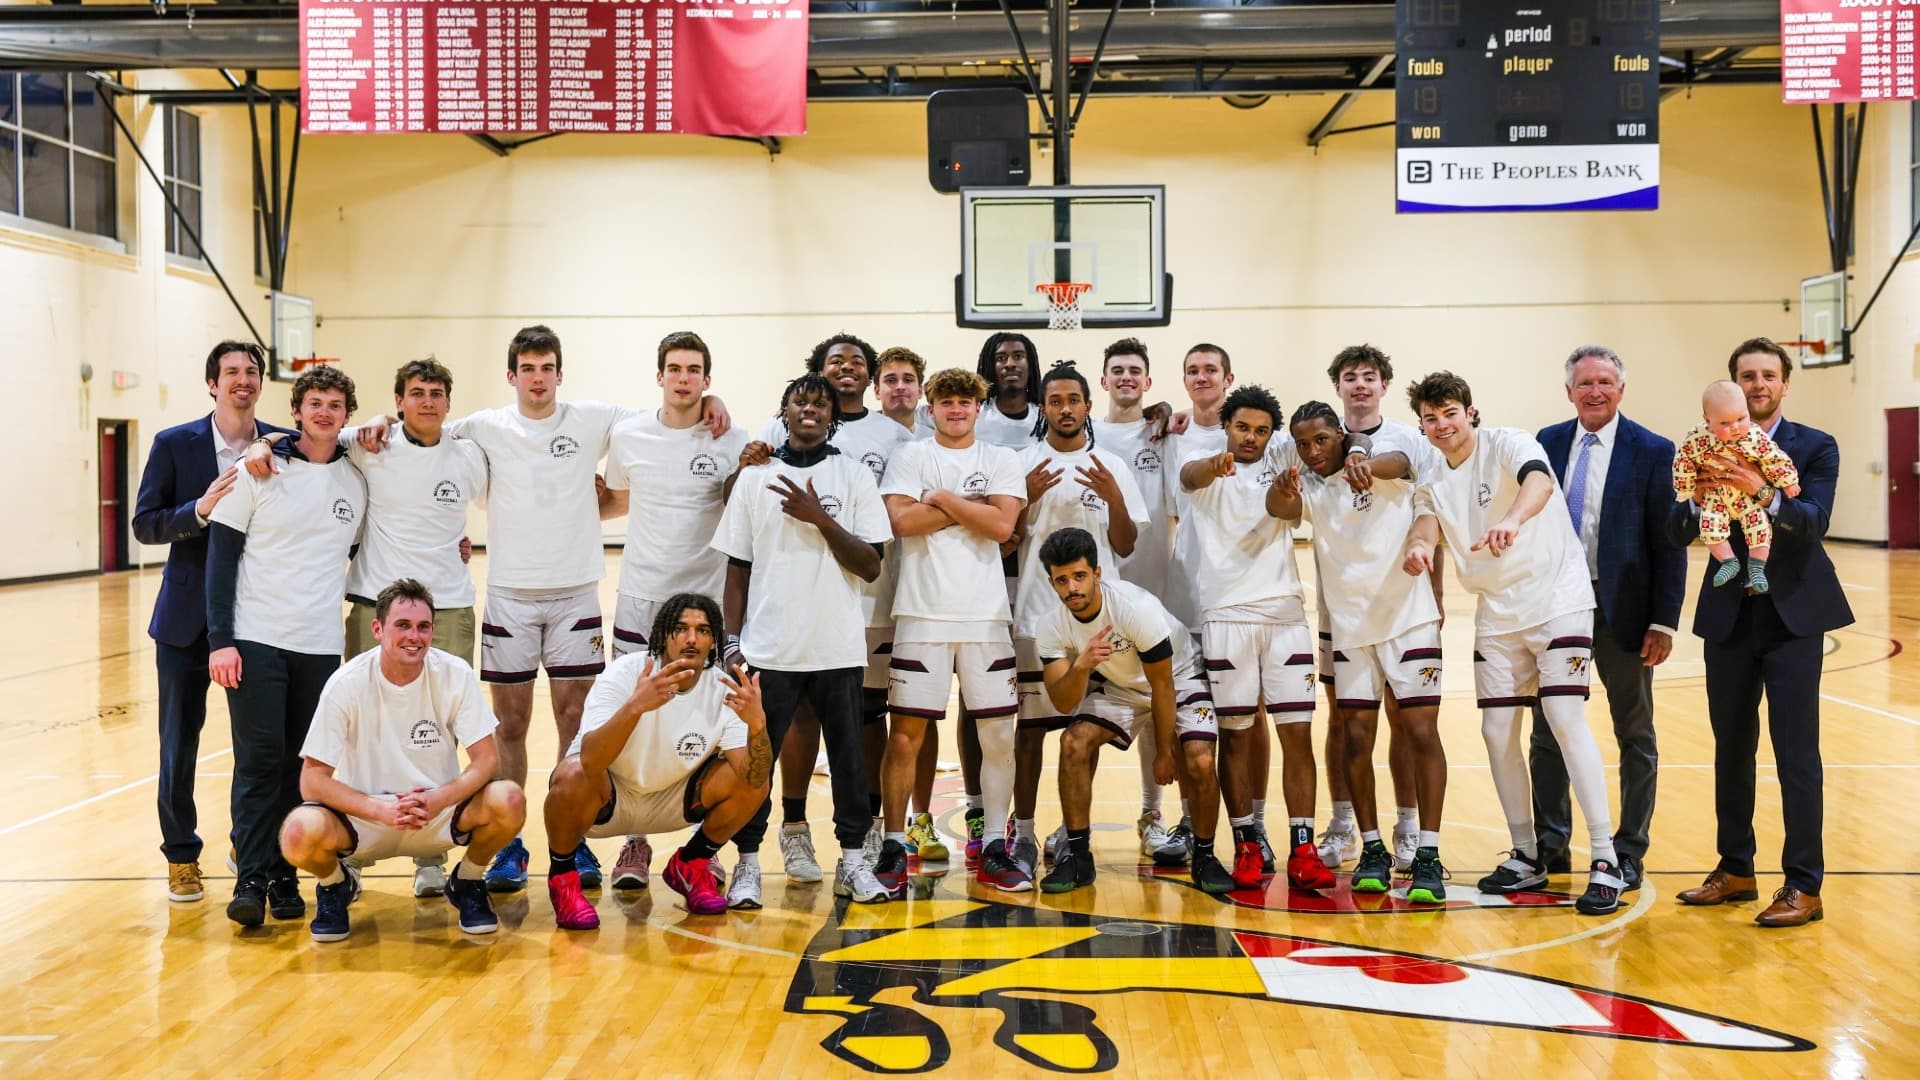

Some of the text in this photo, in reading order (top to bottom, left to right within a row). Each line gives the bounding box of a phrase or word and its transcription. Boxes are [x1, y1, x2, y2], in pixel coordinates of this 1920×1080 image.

[438, 8, 448, 16] JOE
[450, 8, 474, 16] WILSON
[507, 8, 515, 16] 79
[520, 8, 536, 16] 1401
[550, 8, 570, 16] DEREK
[572, 8, 587, 16] CUFF
[507, 18, 515, 26] 79
[520, 18, 536, 26] 1362
[550, 18, 562, 26] BEN
[657, 19, 673, 27] 1547
[438, 29, 448, 37] JOE
[573, 29, 606, 37] BURKHART
[1505, 25, 1552, 46] period
[438, 39, 451, 47] TOM
[521, 39, 536, 47] 1109
[550, 39, 672, 48] GREG ADAMS 1997 2001 1793
[550, 49, 564, 57] EARL
[616, 50, 630, 58] 1997
[635, 50, 650, 58] 2001
[455, 60, 478, 68] KELLER
[616, 60, 632, 68] 2003
[1408, 58, 1444, 75] fouls
[1504, 56, 1553, 75] player
[1614, 55, 1649, 71] fouls
[521, 70, 536, 78] 1410
[550, 70, 672, 79] JONATHAN WEBB 2002 07 1571
[521, 80, 536, 88] 1574
[550, 80, 561, 88] JOE
[616, 81, 632, 89] 2003
[637, 81, 644, 89] 07
[521, 91, 536, 99] 1360
[550, 90, 563, 98] TOM
[521, 101, 536, 109] 1272
[657, 111, 672, 120] 1517
[550, 121, 572, 129] DALLAS
[574, 122, 608, 130] MARSHALL
[1617, 123, 1646, 136] won
[1412, 124, 1440, 139] won
[1509, 123, 1547, 142] game
[1441, 163, 1483, 180] THE
[1492, 162, 1577, 179] PEOPLES
[1586, 161, 1644, 180] BANK
